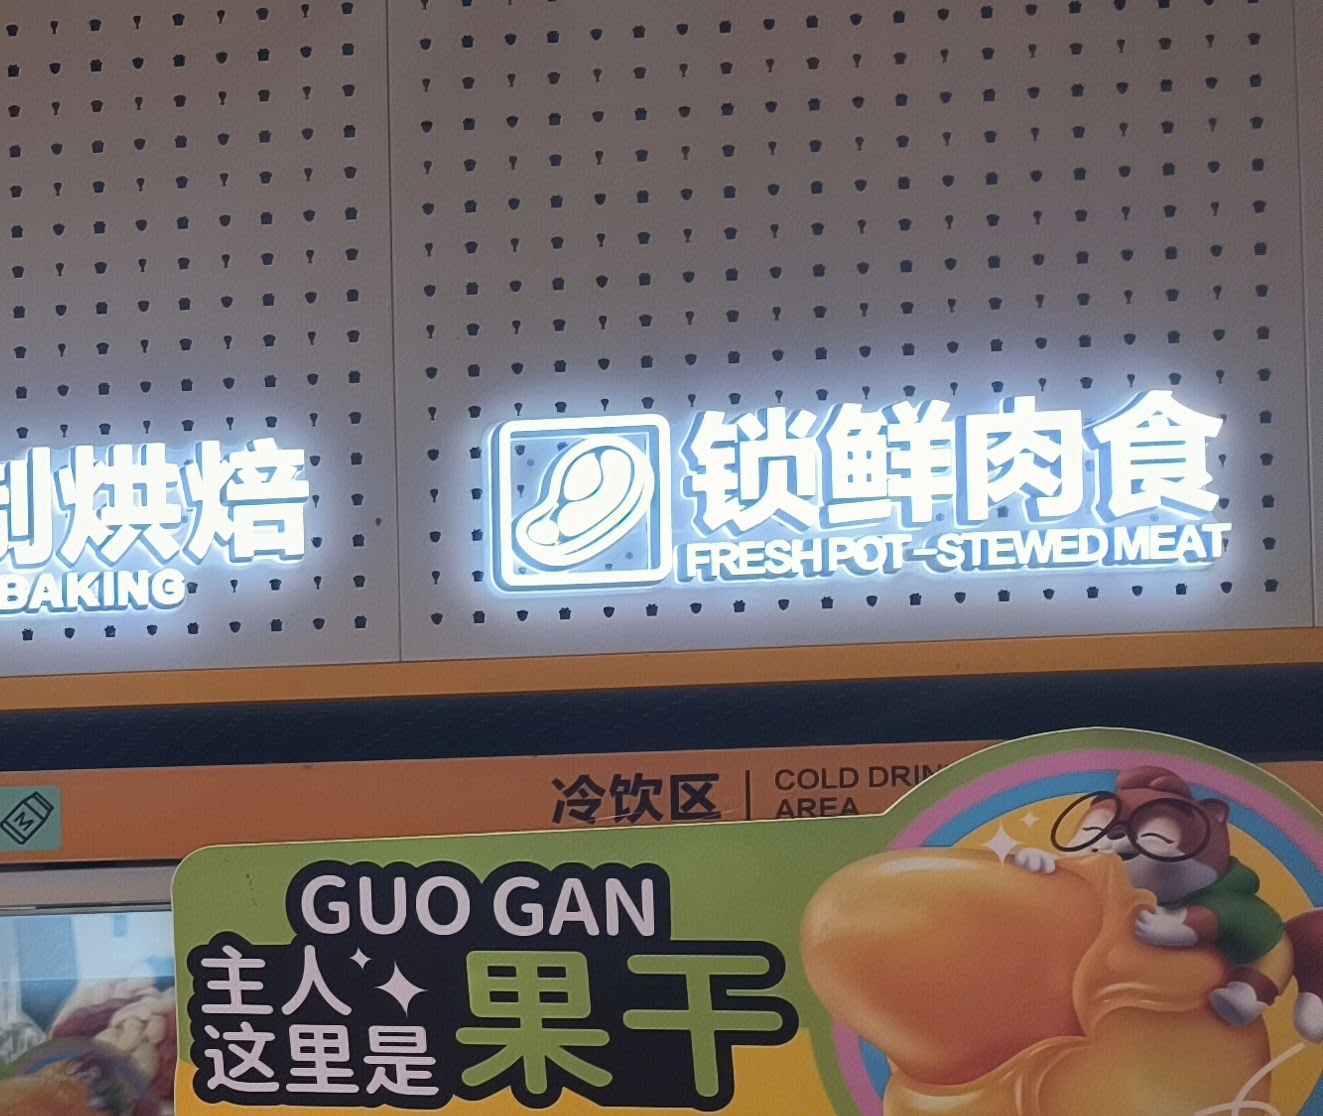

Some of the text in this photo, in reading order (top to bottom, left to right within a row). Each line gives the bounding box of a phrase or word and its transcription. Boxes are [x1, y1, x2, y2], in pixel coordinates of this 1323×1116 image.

[681, 390, 1224, 532] 锁鲜肉食
[683, 534, 821, 582] FRESH
[1114, 521, 1232, 566] MEAT
[551, 772, 723, 824] 冷饮区
[774, 766, 859, 791] COLD
[776, 797, 860, 818] AREA
[300, 873, 657, 938] GUO GAN
[200, 944, 784, 1099] 主人 果干
[203, 1023, 440, 1098] 这里是
